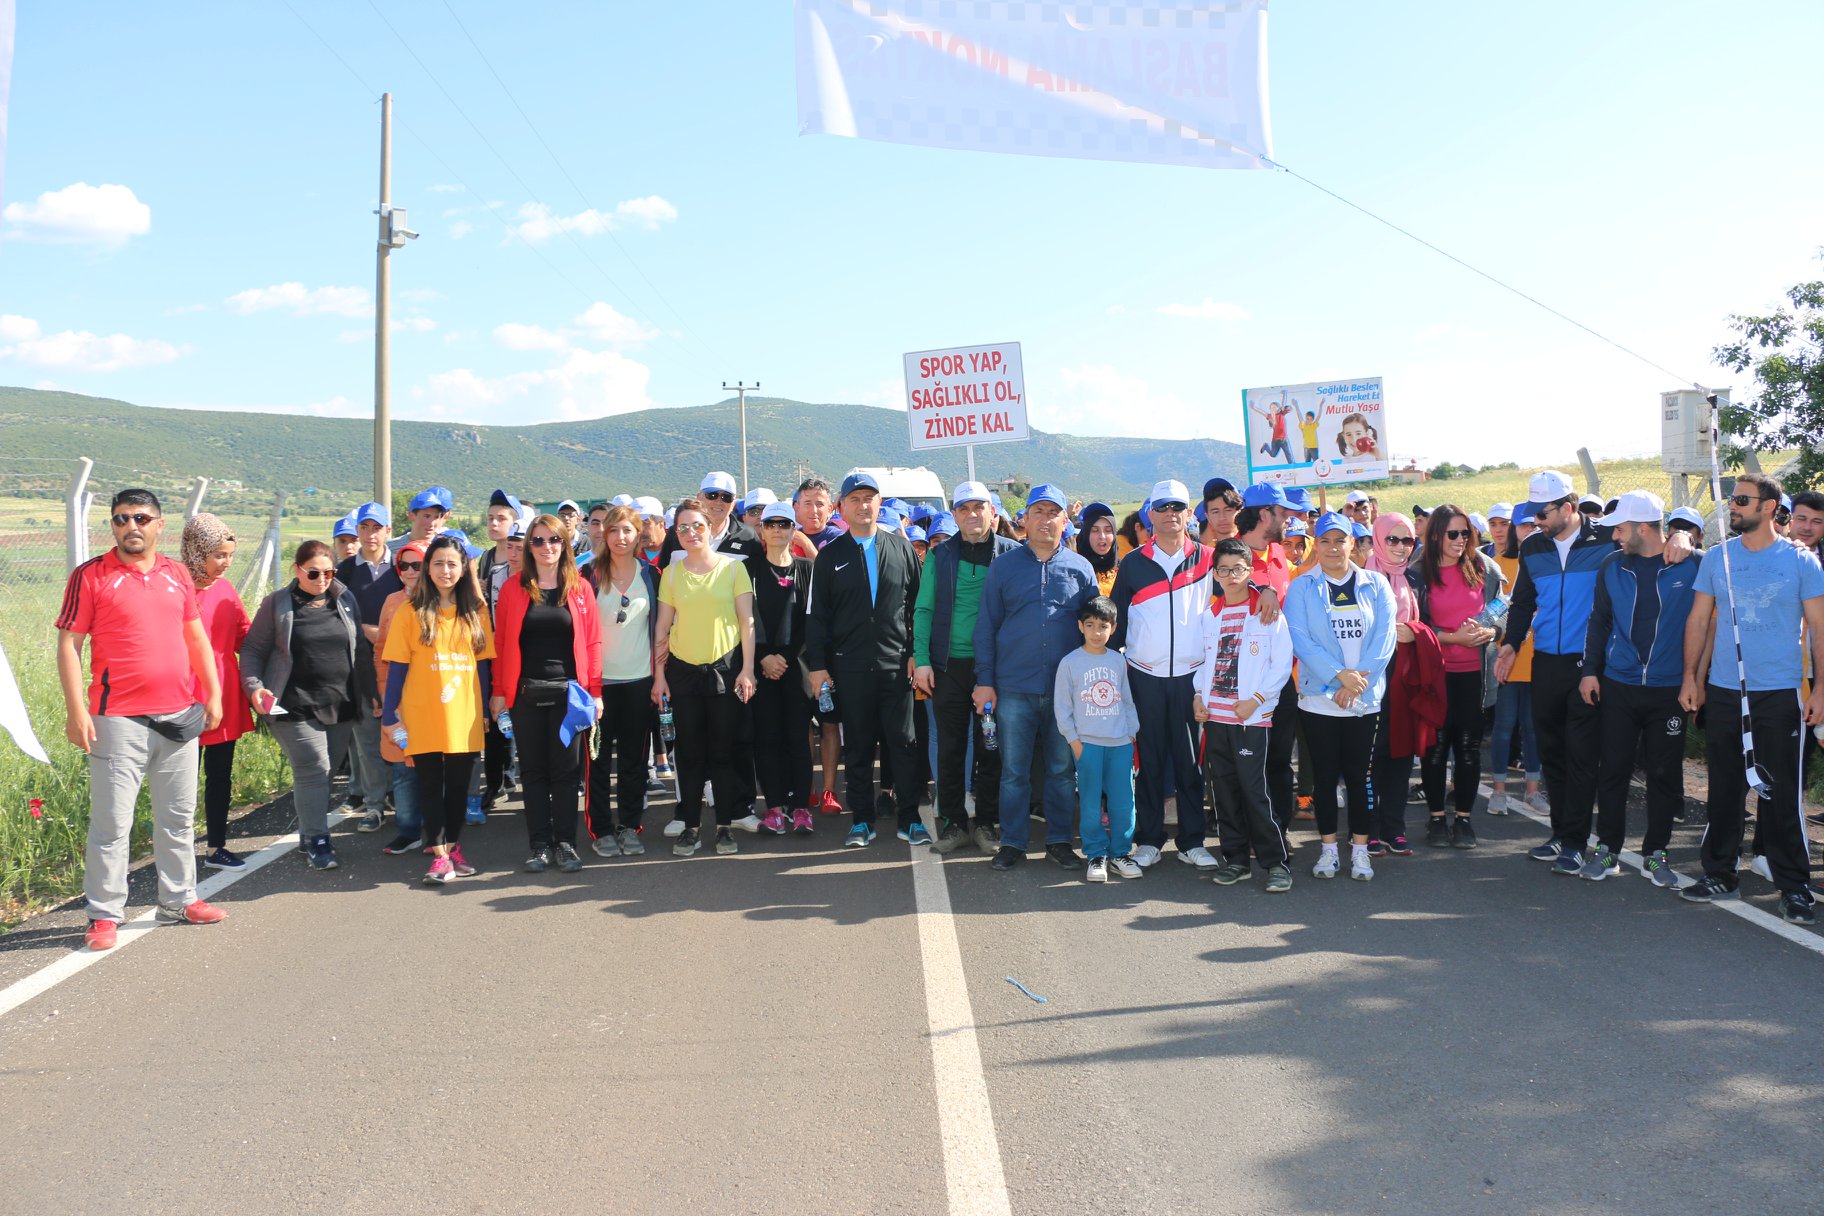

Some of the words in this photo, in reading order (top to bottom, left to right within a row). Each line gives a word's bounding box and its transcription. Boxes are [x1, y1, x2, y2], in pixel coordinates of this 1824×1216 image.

[920, 354, 966, 379] SPOR
[969, 351, 1007, 375] YAP,
[911, 380, 990, 410] SAĞLIKLI
[994, 380, 1021, 405] OL,
[1351, 382, 1379, 392] Beslen
[1337, 392, 1370, 403] Hareket
[1372, 391, 1380, 400] Et
[1326, 404, 1354, 415] Mutlu
[1357, 402, 1380, 413] Yaşa
[924, 412, 977, 440] ZİNDE
[981, 411, 1014, 434] KAL
[1331, 619, 1362, 629] TÜRK
[1083, 666, 1109, 686] PHYS
